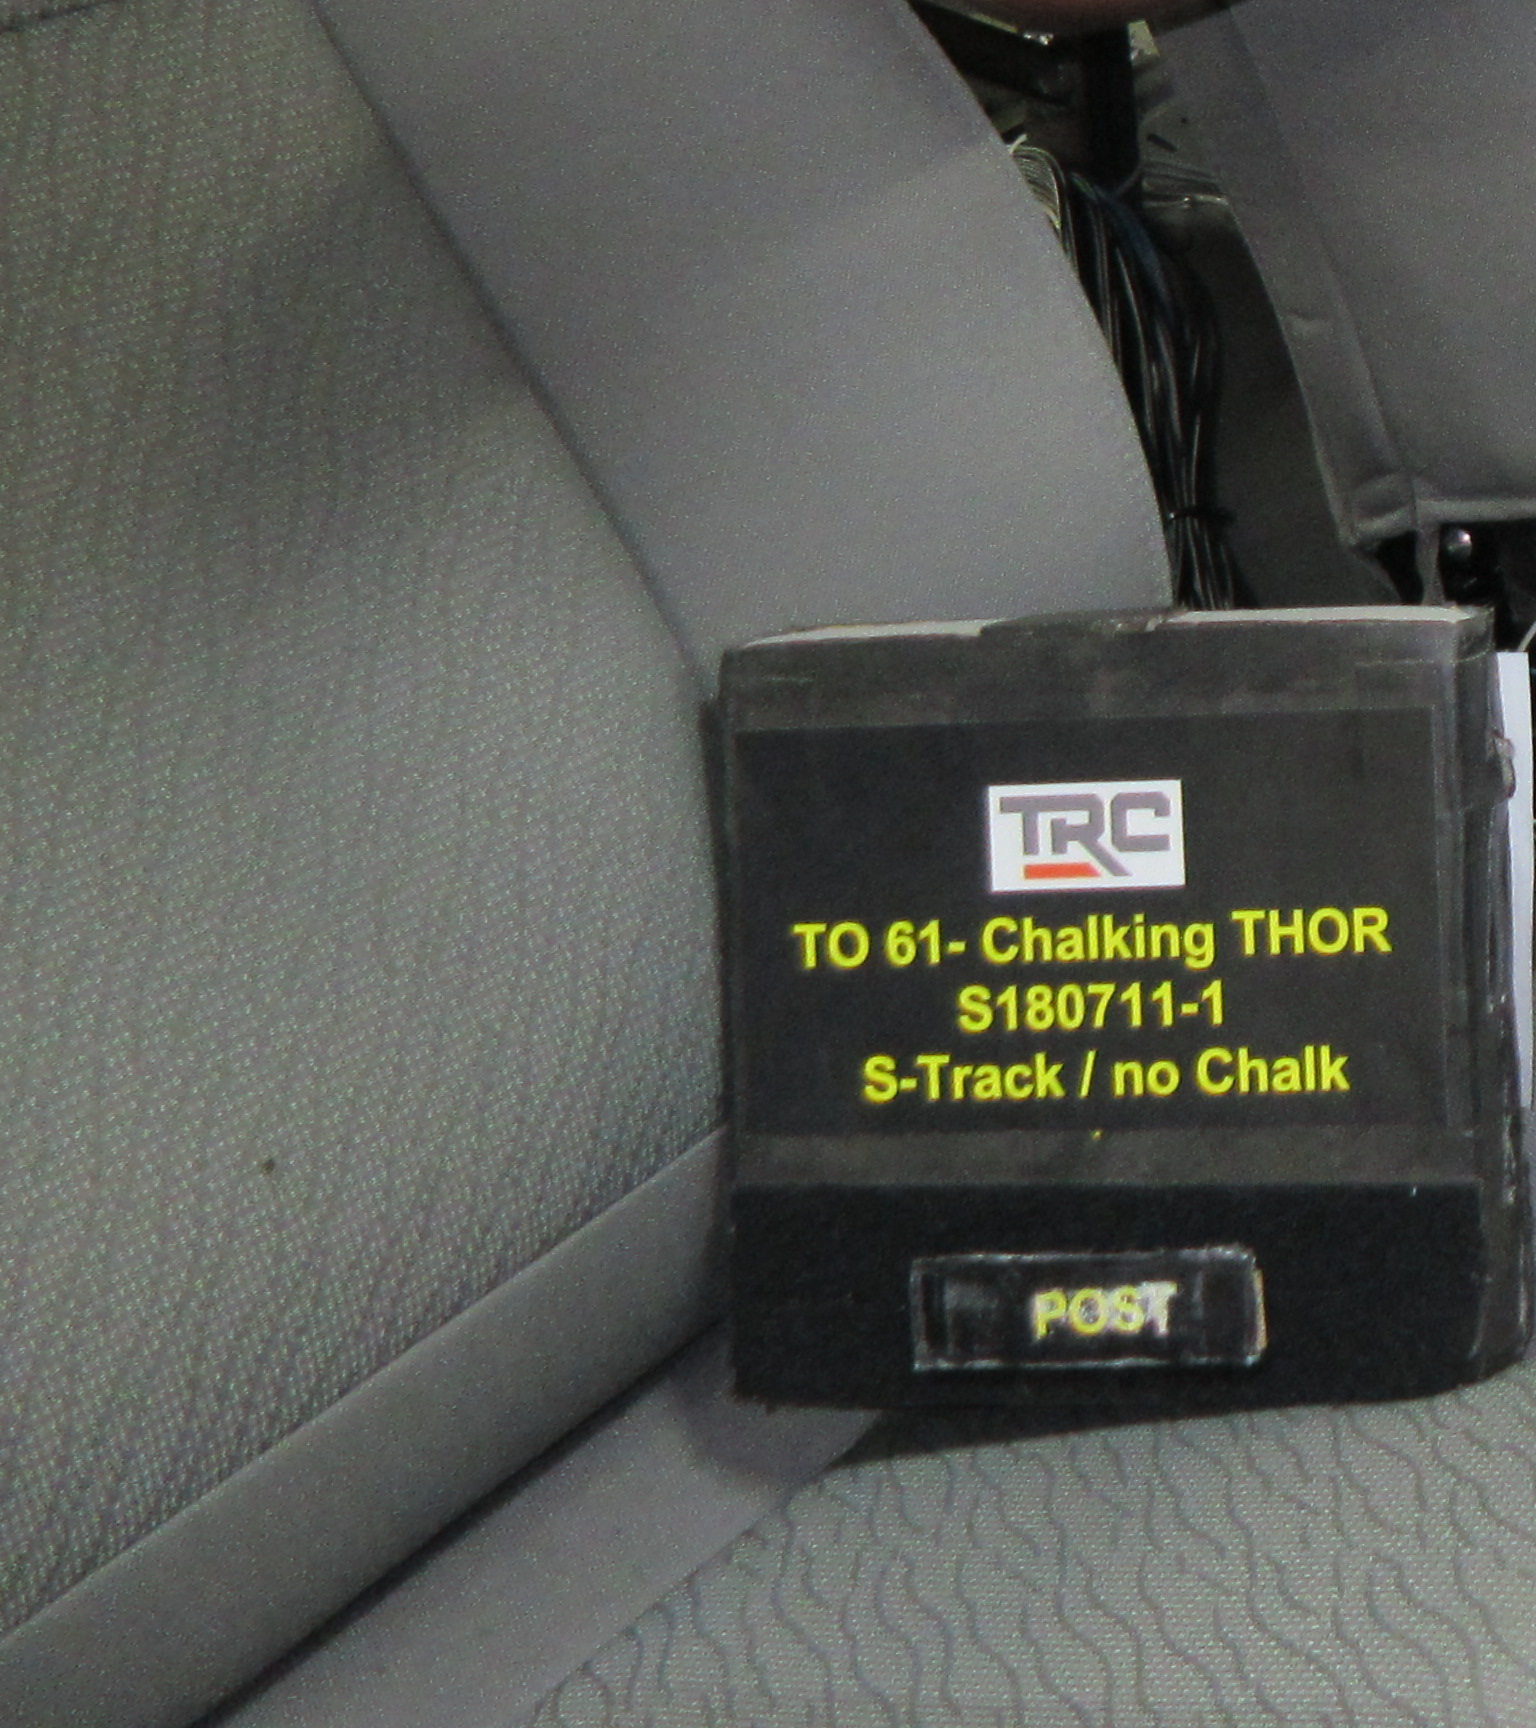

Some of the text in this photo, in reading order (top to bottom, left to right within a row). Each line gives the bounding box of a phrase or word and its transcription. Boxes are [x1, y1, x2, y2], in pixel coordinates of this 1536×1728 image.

[998, 792, 1171, 877] TRC
[792, 905, 1393, 970] TO 61- Chalking THOR
[956, 978, 1226, 1034] S180711-1
[862, 1043, 1352, 1104] S-Track / no Chalk
[1031, 1281, 1178, 1339] POST
